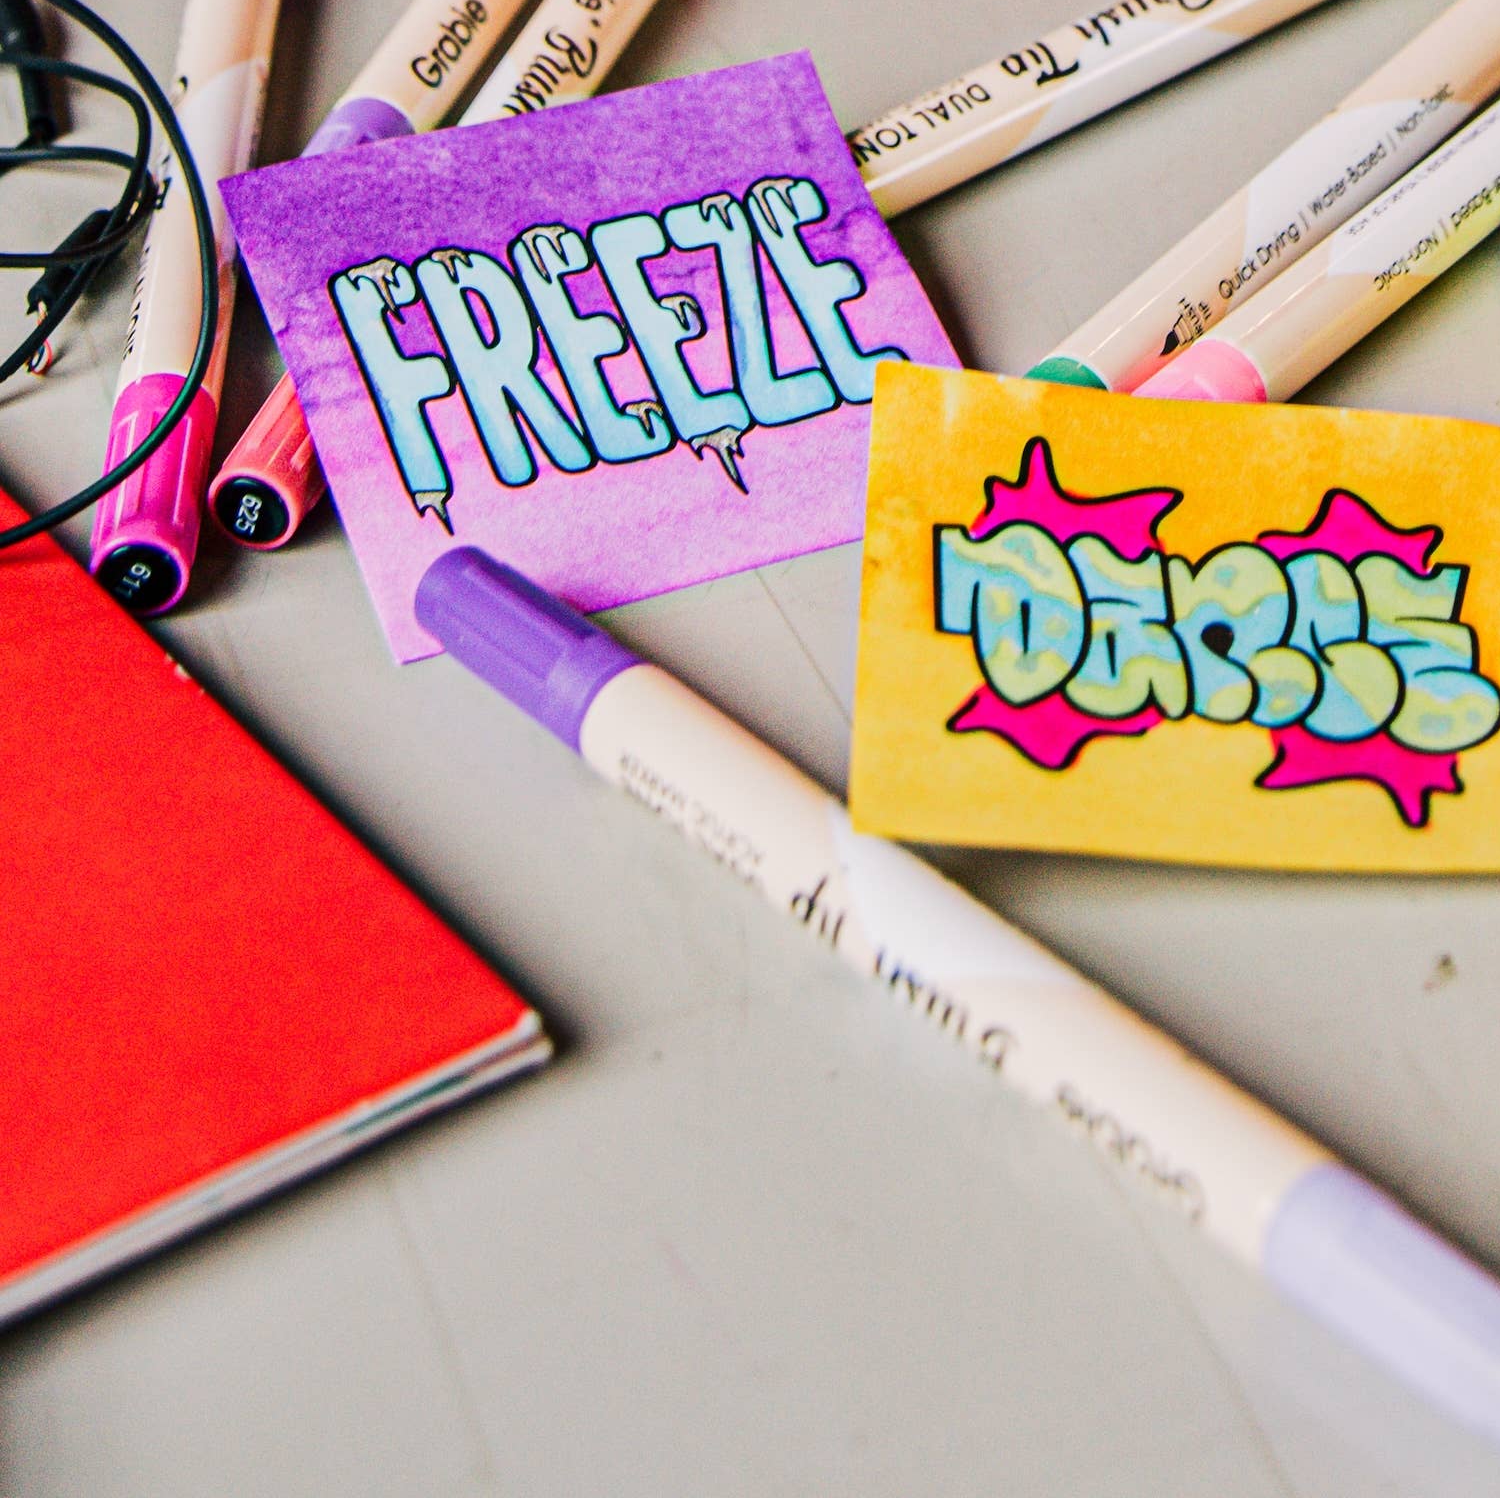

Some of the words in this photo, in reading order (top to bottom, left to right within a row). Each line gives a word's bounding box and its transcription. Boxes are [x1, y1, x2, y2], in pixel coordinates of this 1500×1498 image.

[912, 83, 991, 129] DUAL
[1218, 256, 1258, 300] Quick
[1256, 221, 1300, 267] Drying
[1308, 141, 1388, 217] Water-Based
[328, 176, 910, 535] FREEZE
[234, 494, 263, 535] 625
[114, 562, 151, 599] 611
